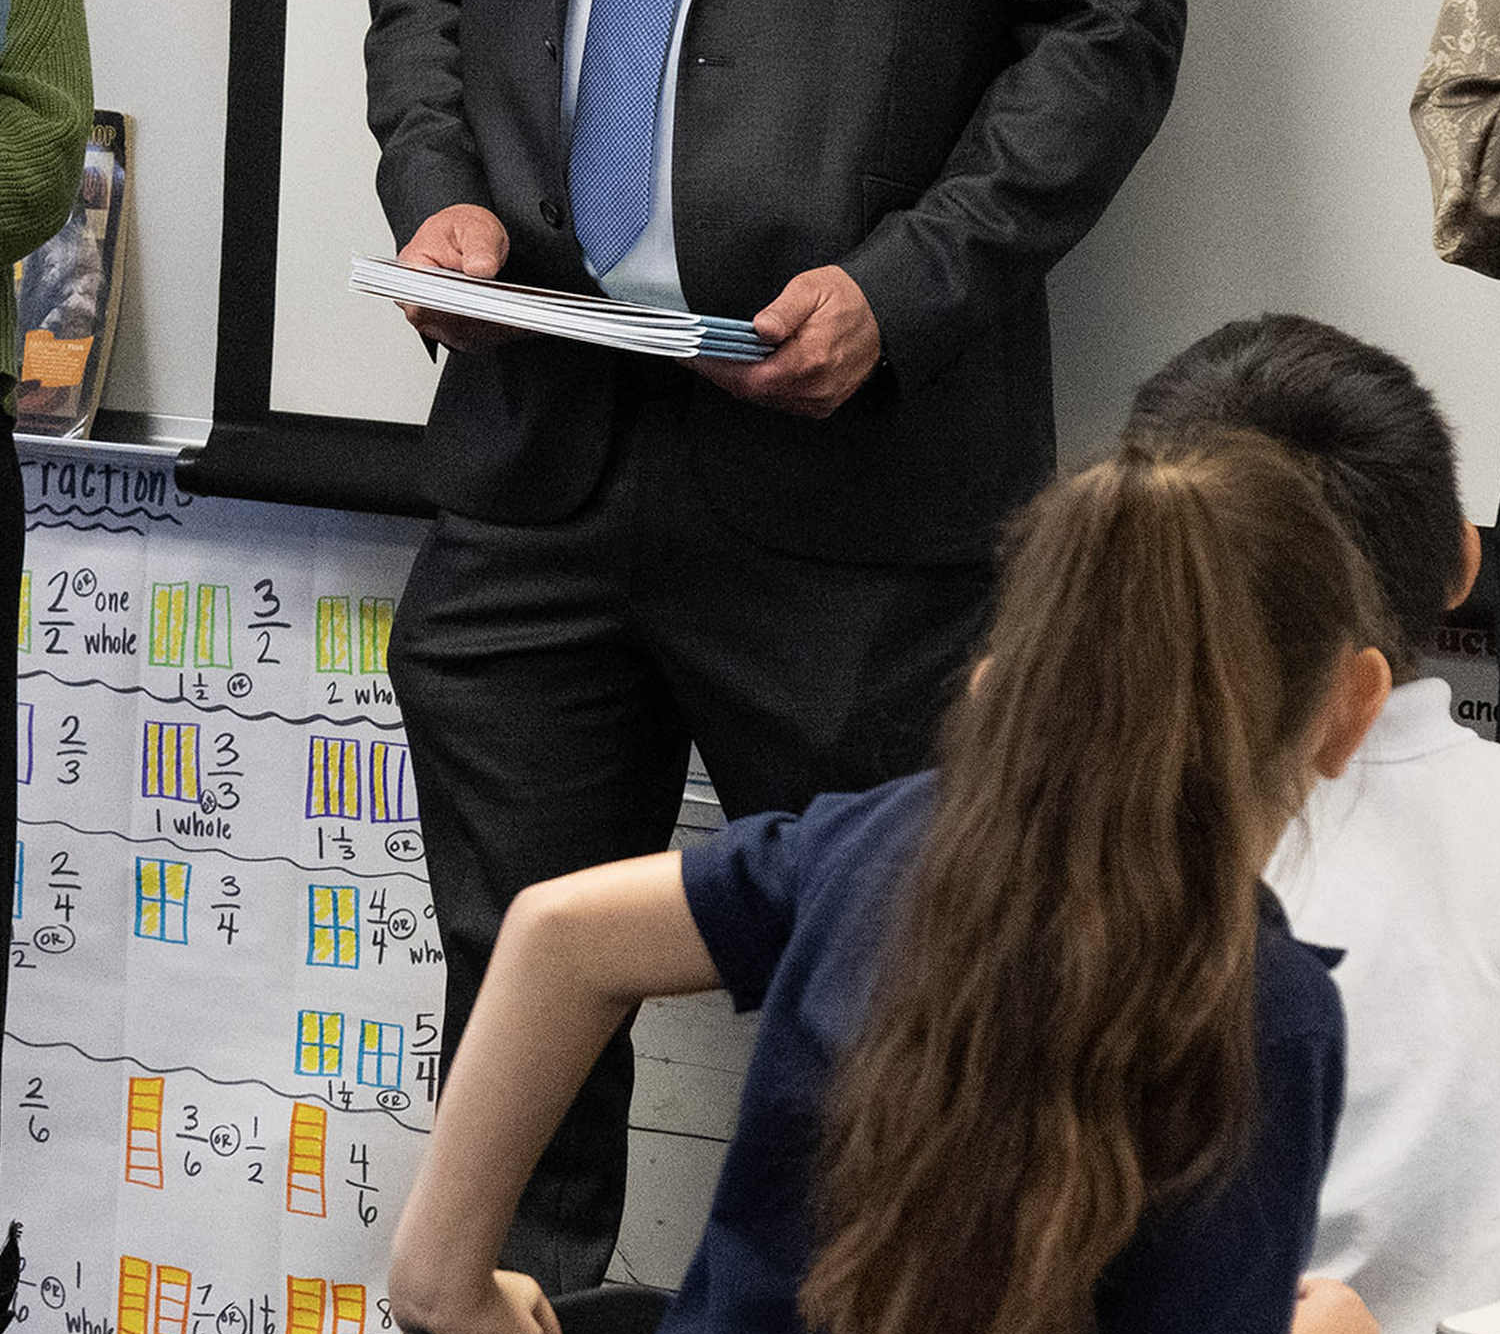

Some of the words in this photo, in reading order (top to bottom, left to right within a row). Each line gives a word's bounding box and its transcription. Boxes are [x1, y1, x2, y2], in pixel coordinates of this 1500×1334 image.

[20, 461, 194, 507] raction
[47, 571, 69, 614] 2
[94, 588, 129, 613] one
[254, 578, 282, 617] 3
[44, 627, 69, 655] 2
[84, 629, 138, 656] whole
[257, 632, 281, 665] 2
[327, 681, 343, 705] 2
[354, 680, 394, 705] who
[61, 716, 81, 746] 2
[213, 733, 240, 767] 3
[57, 760, 81, 784] 3
[216, 782, 241, 811] 3
[173, 811, 232, 841] whole
[389, 839, 417, 853] OR
[50, 851, 80, 876] 2
[221, 874, 242, 898] 3
[54, 893, 75, 923] 4
[369, 887, 387, 920] 4
[39, 932, 66, 945] OR
[217, 910, 240, 946] 4
[11, 949, 37, 969] 2
[371, 927, 389, 966] 4
[416, 1012, 438, 1048] 5
[26, 1078, 44, 1099] 2
[416, 1056, 438, 1103] 4
[382, 1094, 402, 1107] OR
[29, 1115, 50, 1143] 6
[184, 1105, 199, 1131] 3
[214, 1131, 232, 1147] OR
[185, 1152, 202, 1176] 6
[248, 1163, 264, 1184] 2
[349, 1143, 369, 1185] 4
[358, 1191, 378, 1227] 6
[197, 1284, 213, 1304] 7
[380, 1298, 394, 1329] 8
